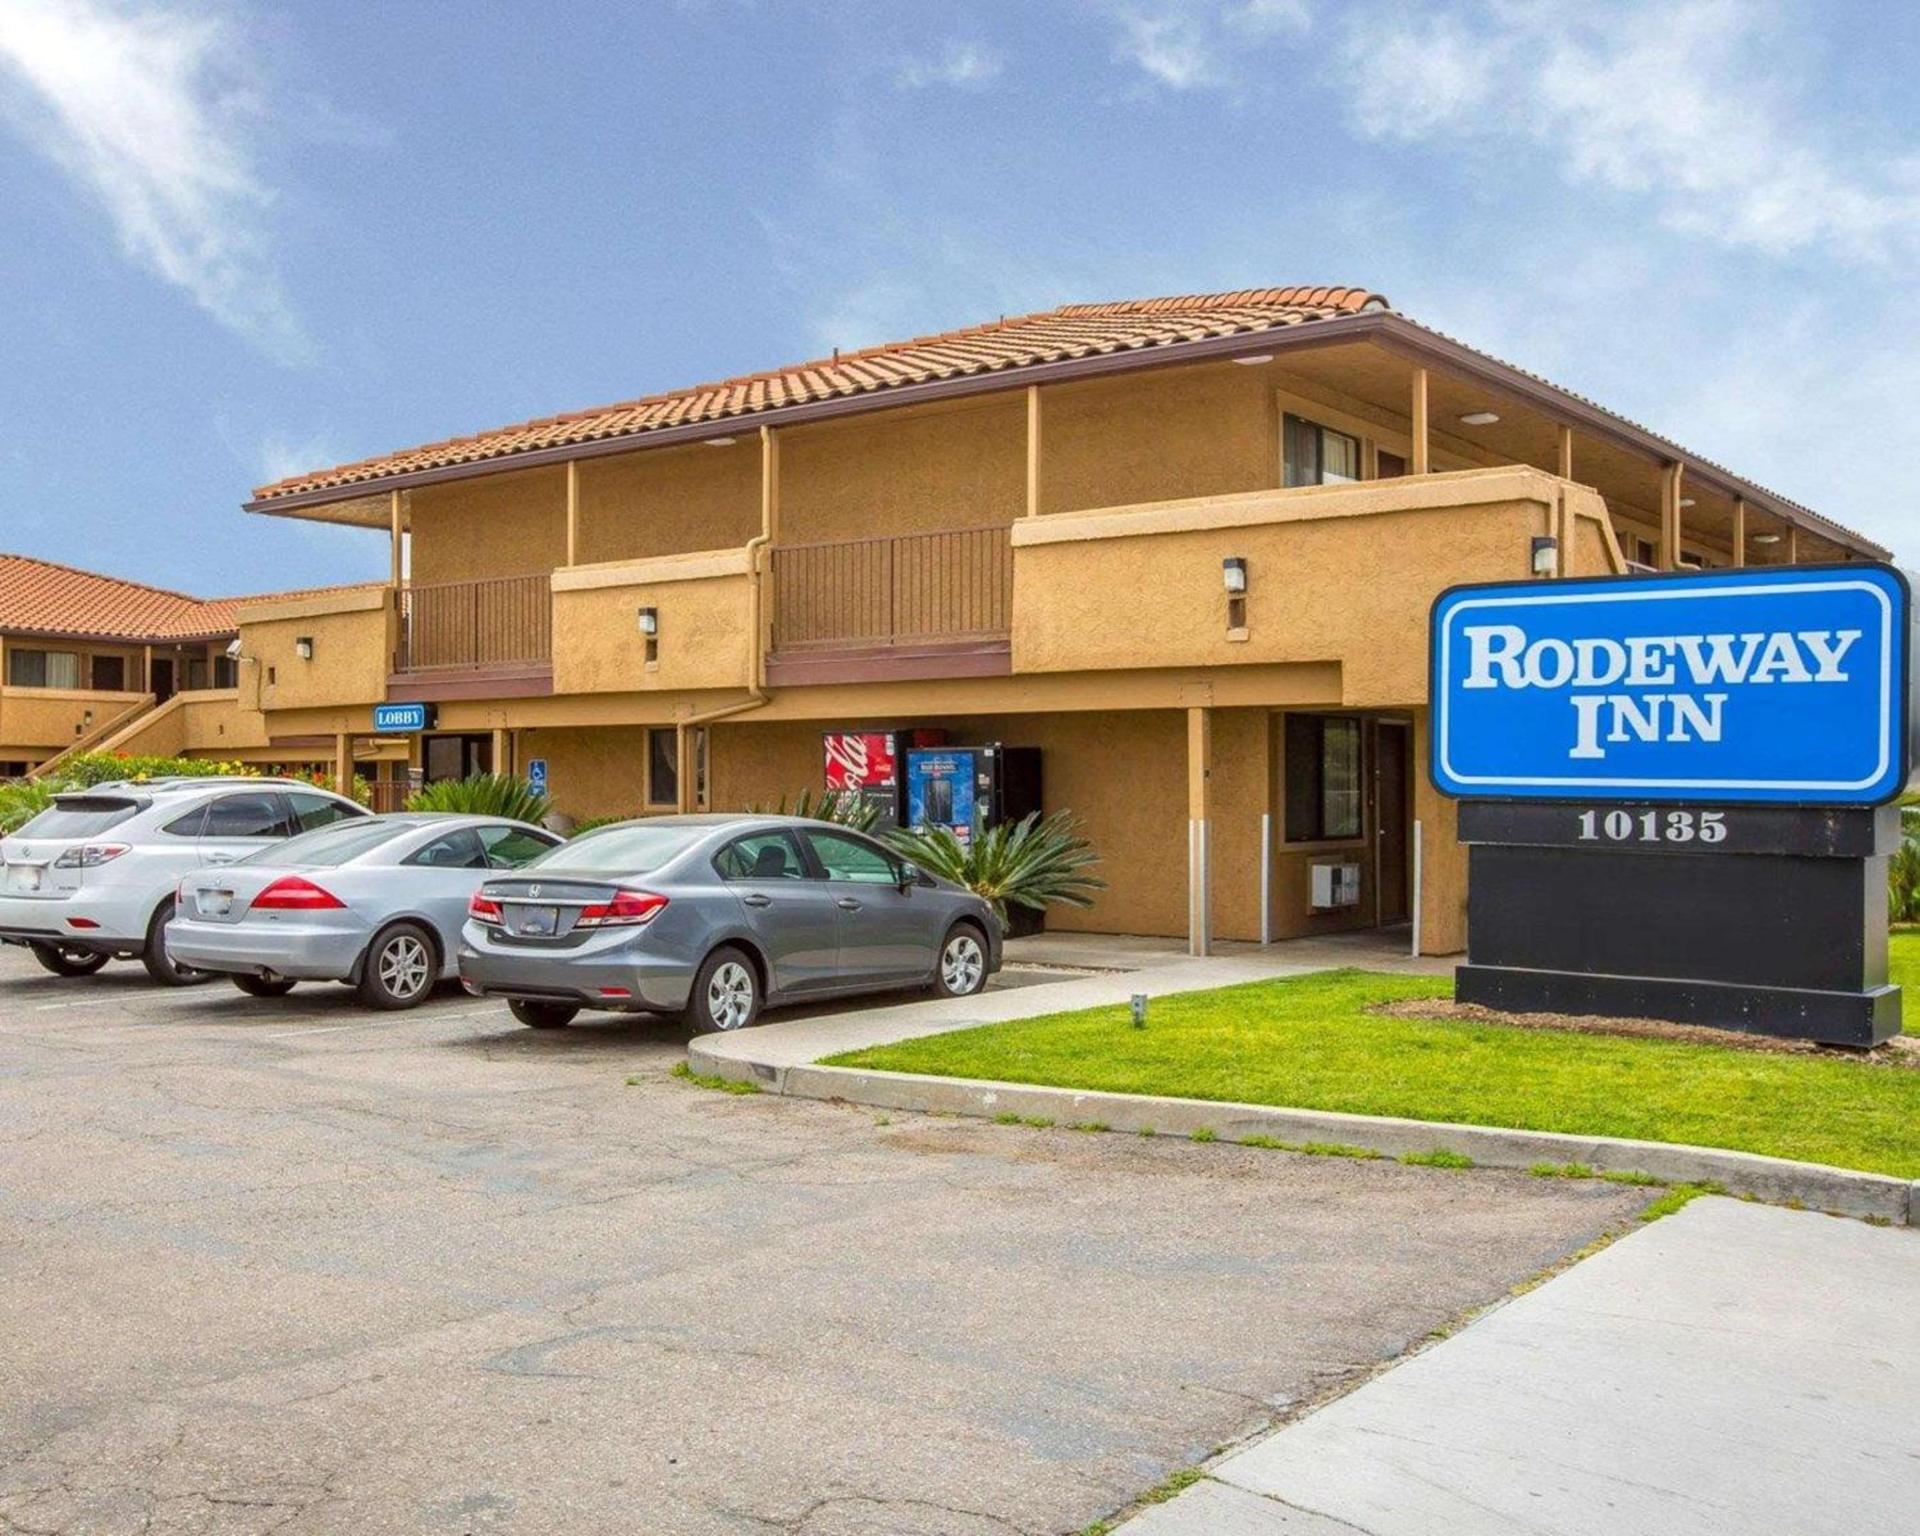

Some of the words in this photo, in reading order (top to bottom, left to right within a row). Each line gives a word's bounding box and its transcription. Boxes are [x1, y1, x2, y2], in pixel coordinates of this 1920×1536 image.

[1462, 624, 1862, 689] RODEWAY
[378, 710, 421, 725] LOBBY
[1569, 693, 1728, 758] INN
[1578, 809, 1727, 843] 10135
